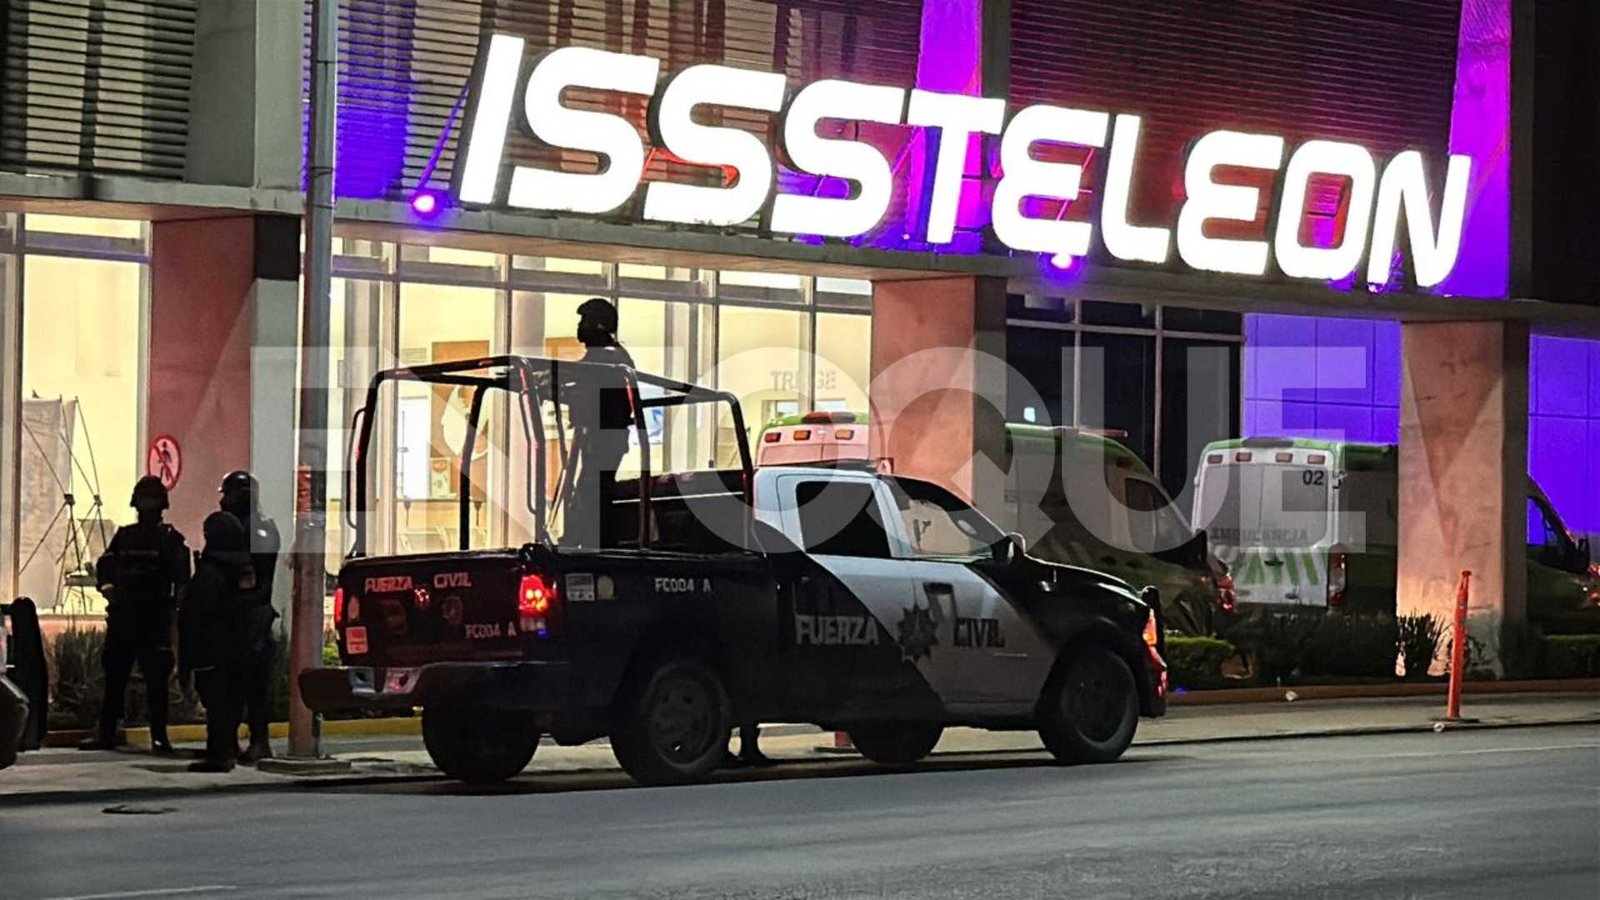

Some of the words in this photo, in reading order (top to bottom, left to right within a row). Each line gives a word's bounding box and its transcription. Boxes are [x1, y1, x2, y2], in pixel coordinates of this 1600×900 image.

[459, 34, 1471, 287] ISSSTELEON
[1302, 469, 1324, 486] 02
[365, 575, 413, 592] FUERZA
[434, 572, 472, 588] CIVIL
[703, 578, 711, 592] A
[796, 614, 878, 645] FUERZA
[954, 617, 1005, 648] CIVIL
